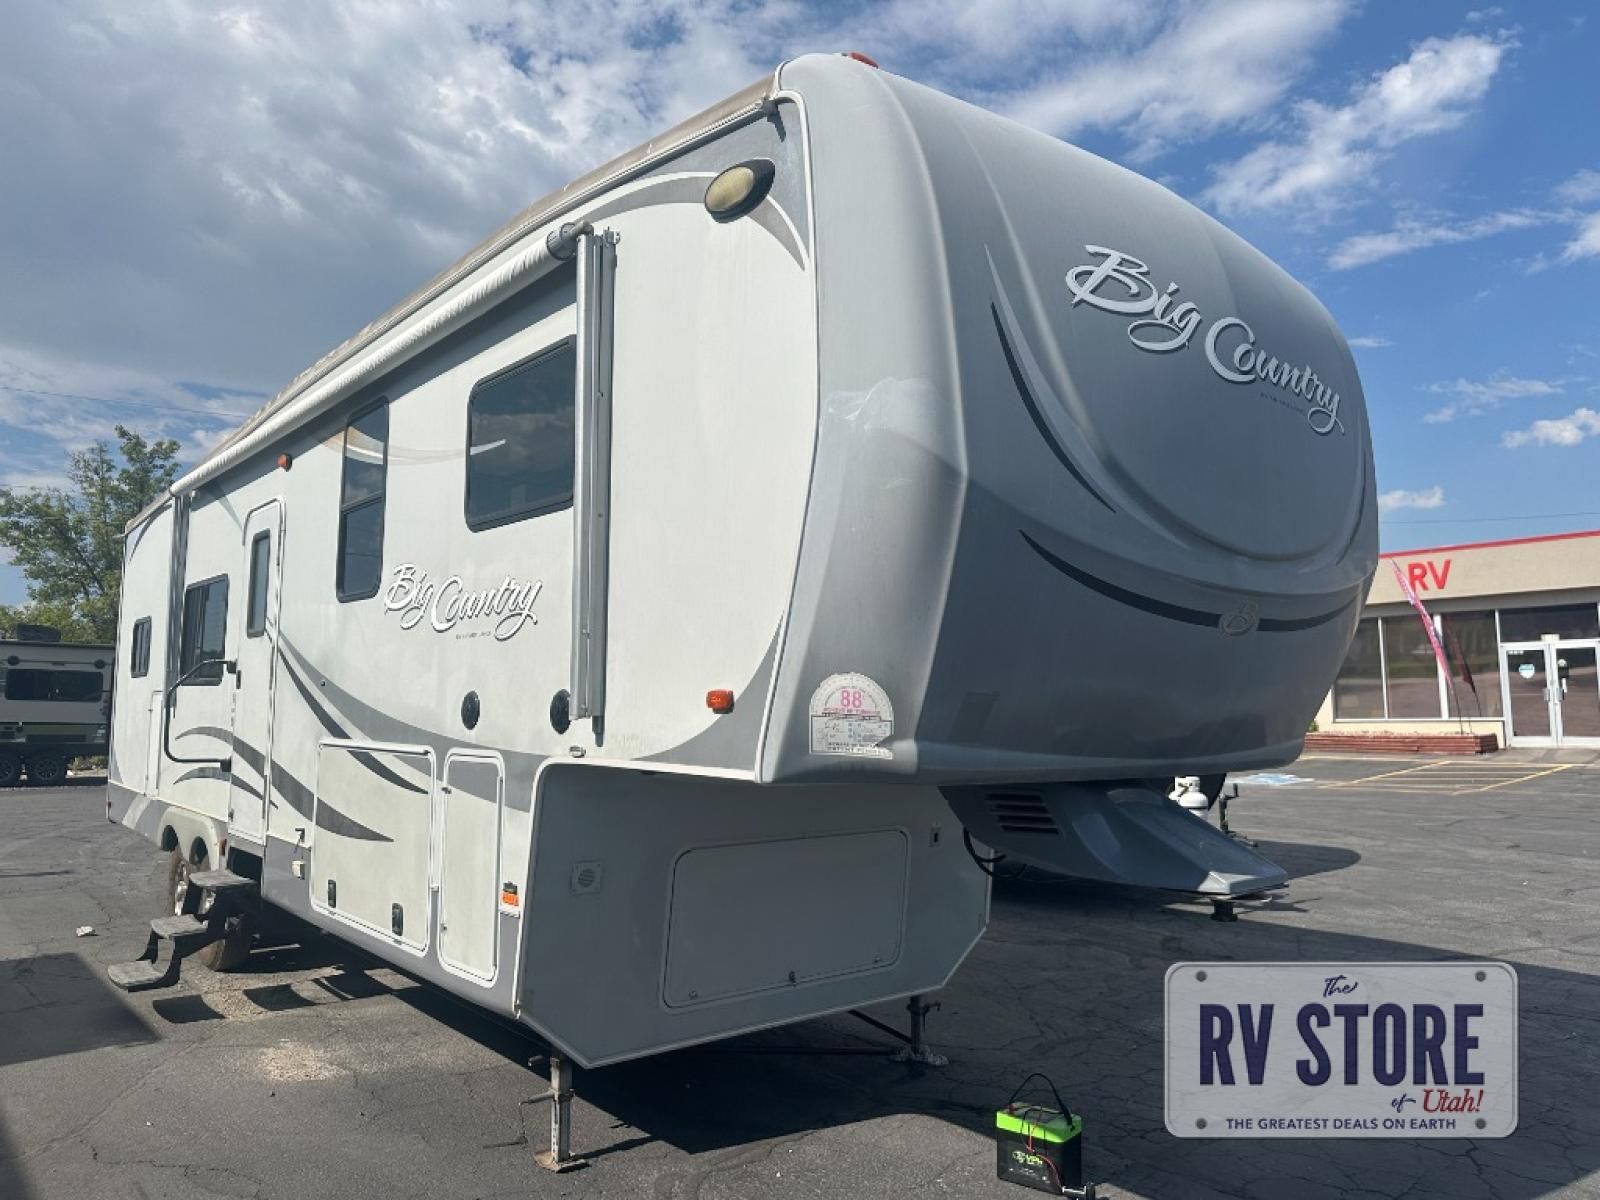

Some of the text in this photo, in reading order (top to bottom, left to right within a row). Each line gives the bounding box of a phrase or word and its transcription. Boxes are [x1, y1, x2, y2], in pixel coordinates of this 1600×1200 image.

[1065, 244, 1345, 434] Big Country
[384, 563, 543, 642] Big Country
[1407, 560, 1452, 591] RV
[840, 690, 862, 708] 88
